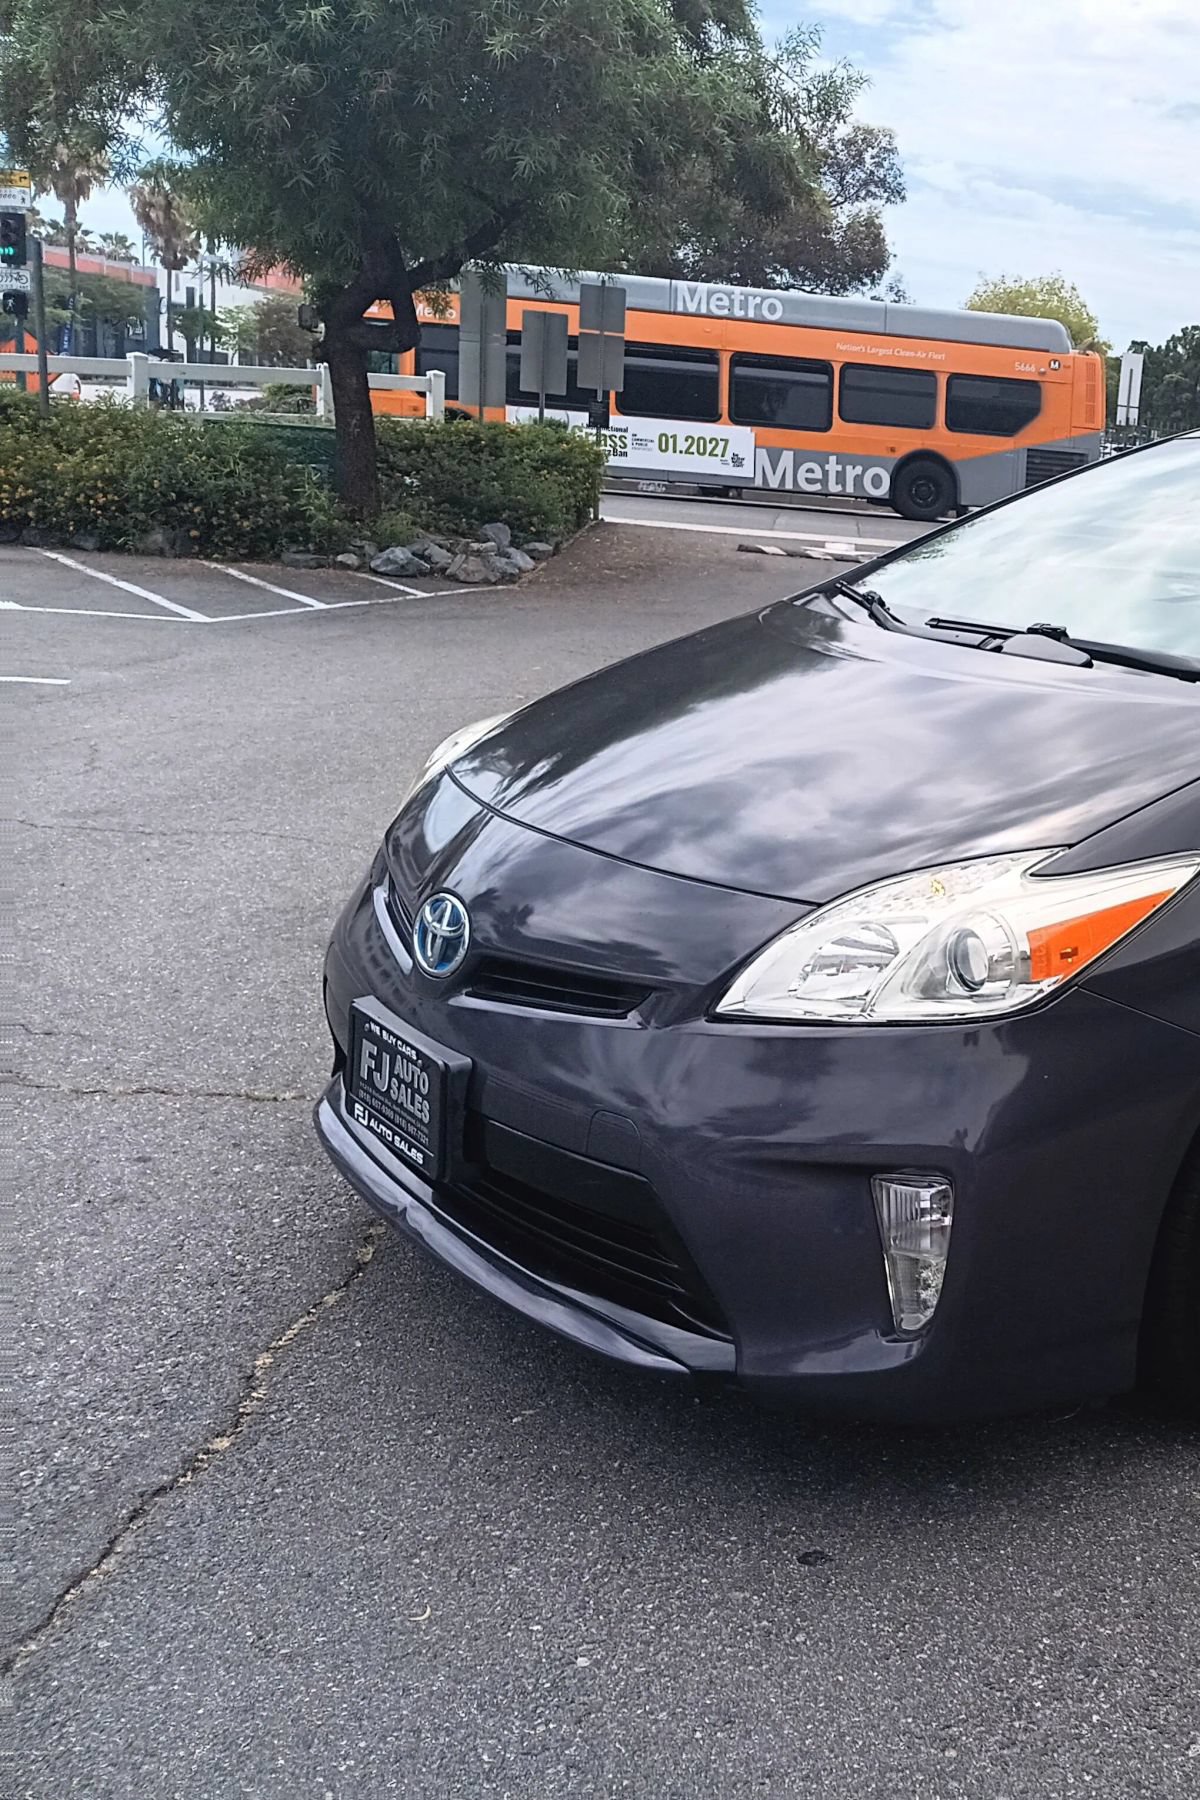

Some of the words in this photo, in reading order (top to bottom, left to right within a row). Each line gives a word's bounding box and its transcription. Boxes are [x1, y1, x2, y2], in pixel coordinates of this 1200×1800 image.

[676, 284, 783, 321] Metro
[867, 346, 893, 356] Largest
[658, 432, 729, 458] 01.2027
[754, 448, 890, 496] Metro
[370, 1021, 381, 1036] WE
[382, 1029, 397, 1046] BUY
[397, 1040, 417, 1060] CARS
[360, 1038, 389, 1092] FJ
[394, 1054, 429, 1095] AUTO
[390, 1077, 430, 1124] SALES
[354, 1102, 369, 1126] FJ
[369, 1118, 393, 1142] AUTO
[394, 1135, 423, 1165] SALES
